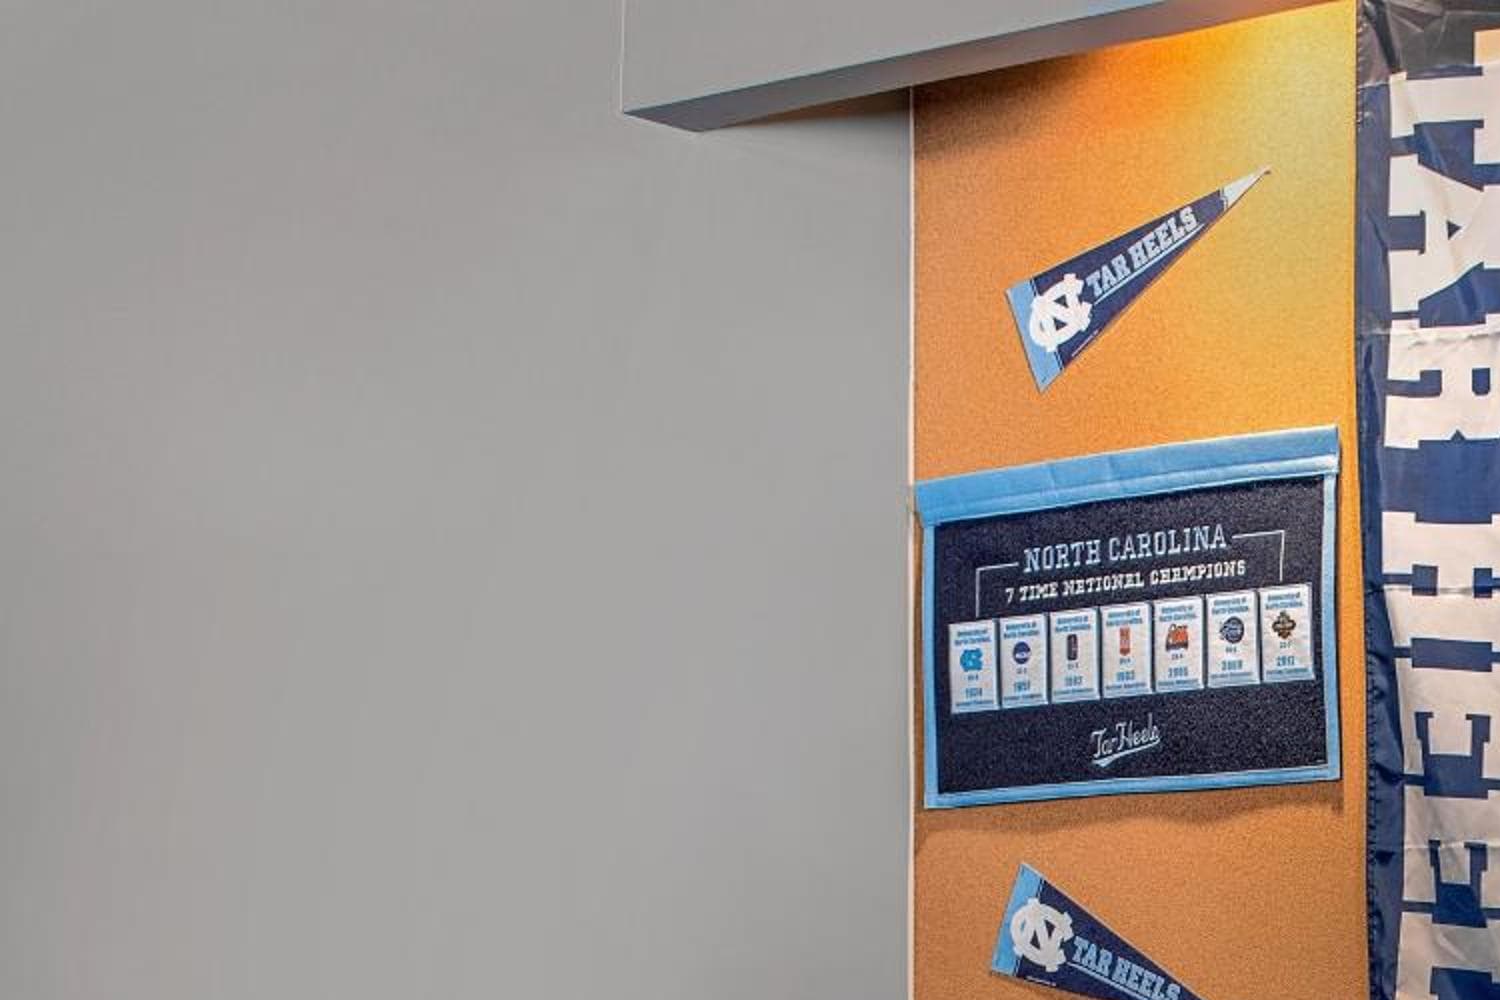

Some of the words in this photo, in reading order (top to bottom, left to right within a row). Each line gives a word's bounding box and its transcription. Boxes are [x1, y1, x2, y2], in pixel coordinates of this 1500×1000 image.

[1085, 254, 1131, 297] TAR
[1127, 206, 1198, 270] HEELS
[1023, 539, 1101, 573] NORTH
[1108, 523, 1227, 562] CAROLINA
[1005, 587, 1015, 604] 7
[1019, 581, 1059, 601] TIME
[1072, 935, 1114, 979] TAR
